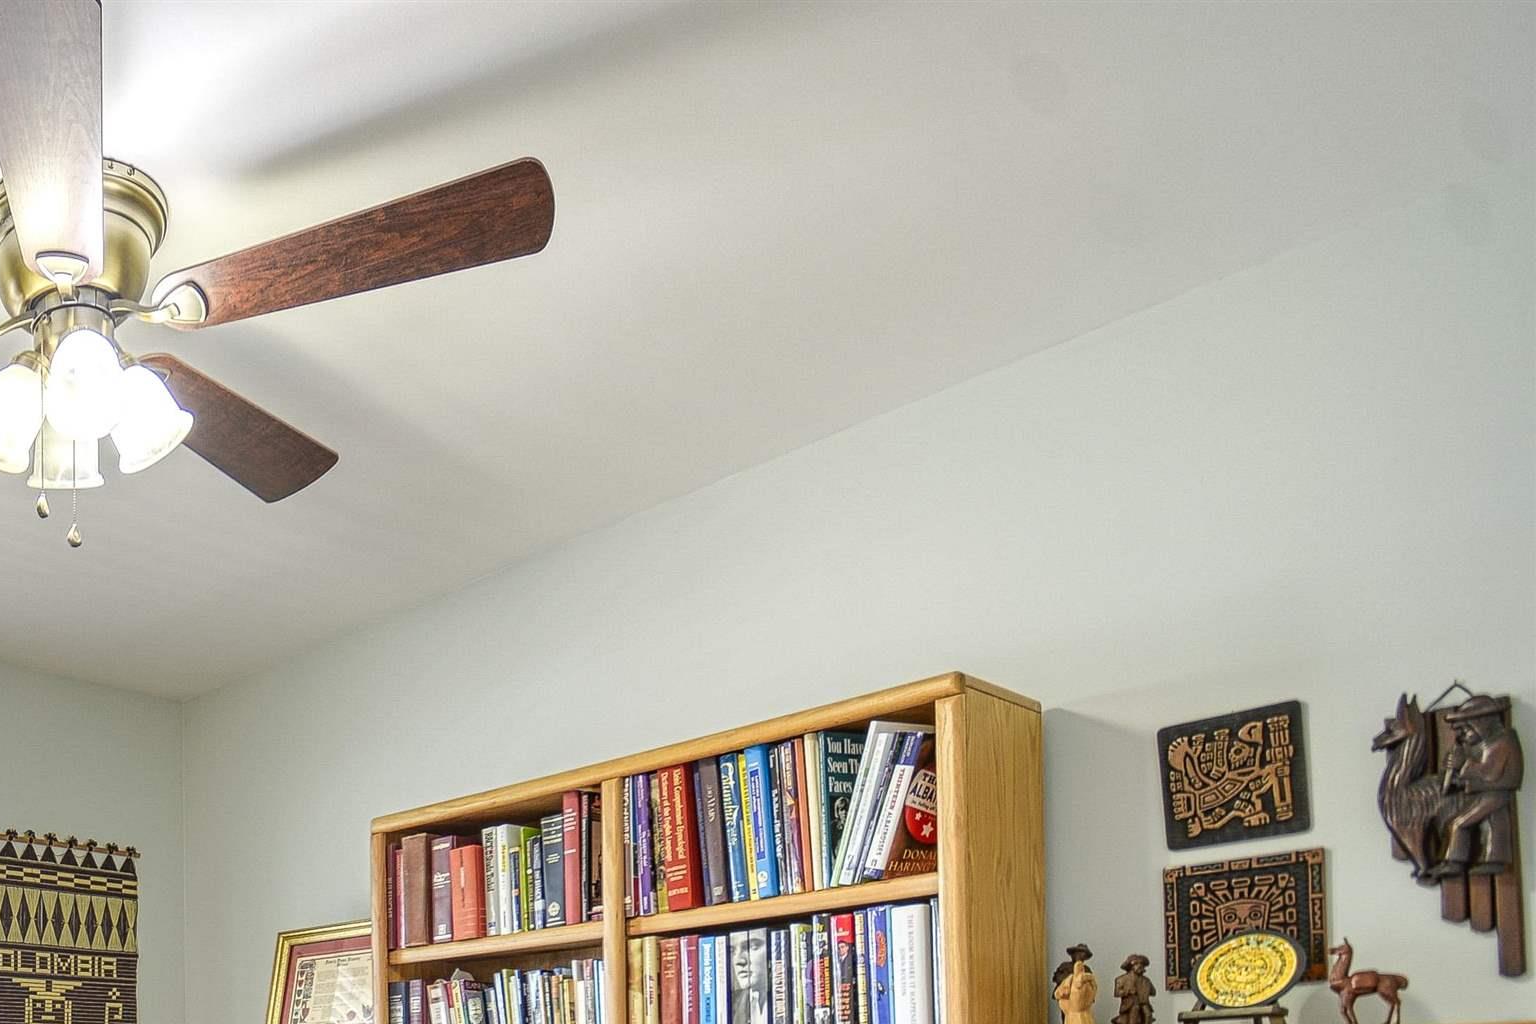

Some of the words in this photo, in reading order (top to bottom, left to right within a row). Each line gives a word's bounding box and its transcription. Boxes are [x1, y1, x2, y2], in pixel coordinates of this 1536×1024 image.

[826, 737, 841, 753] You
[827, 758, 848, 773] Seen
[660, 772, 671, 801] Dictionary
[889, 768, 907, 812] THIRTEEN
[664, 807, 672, 818] the
